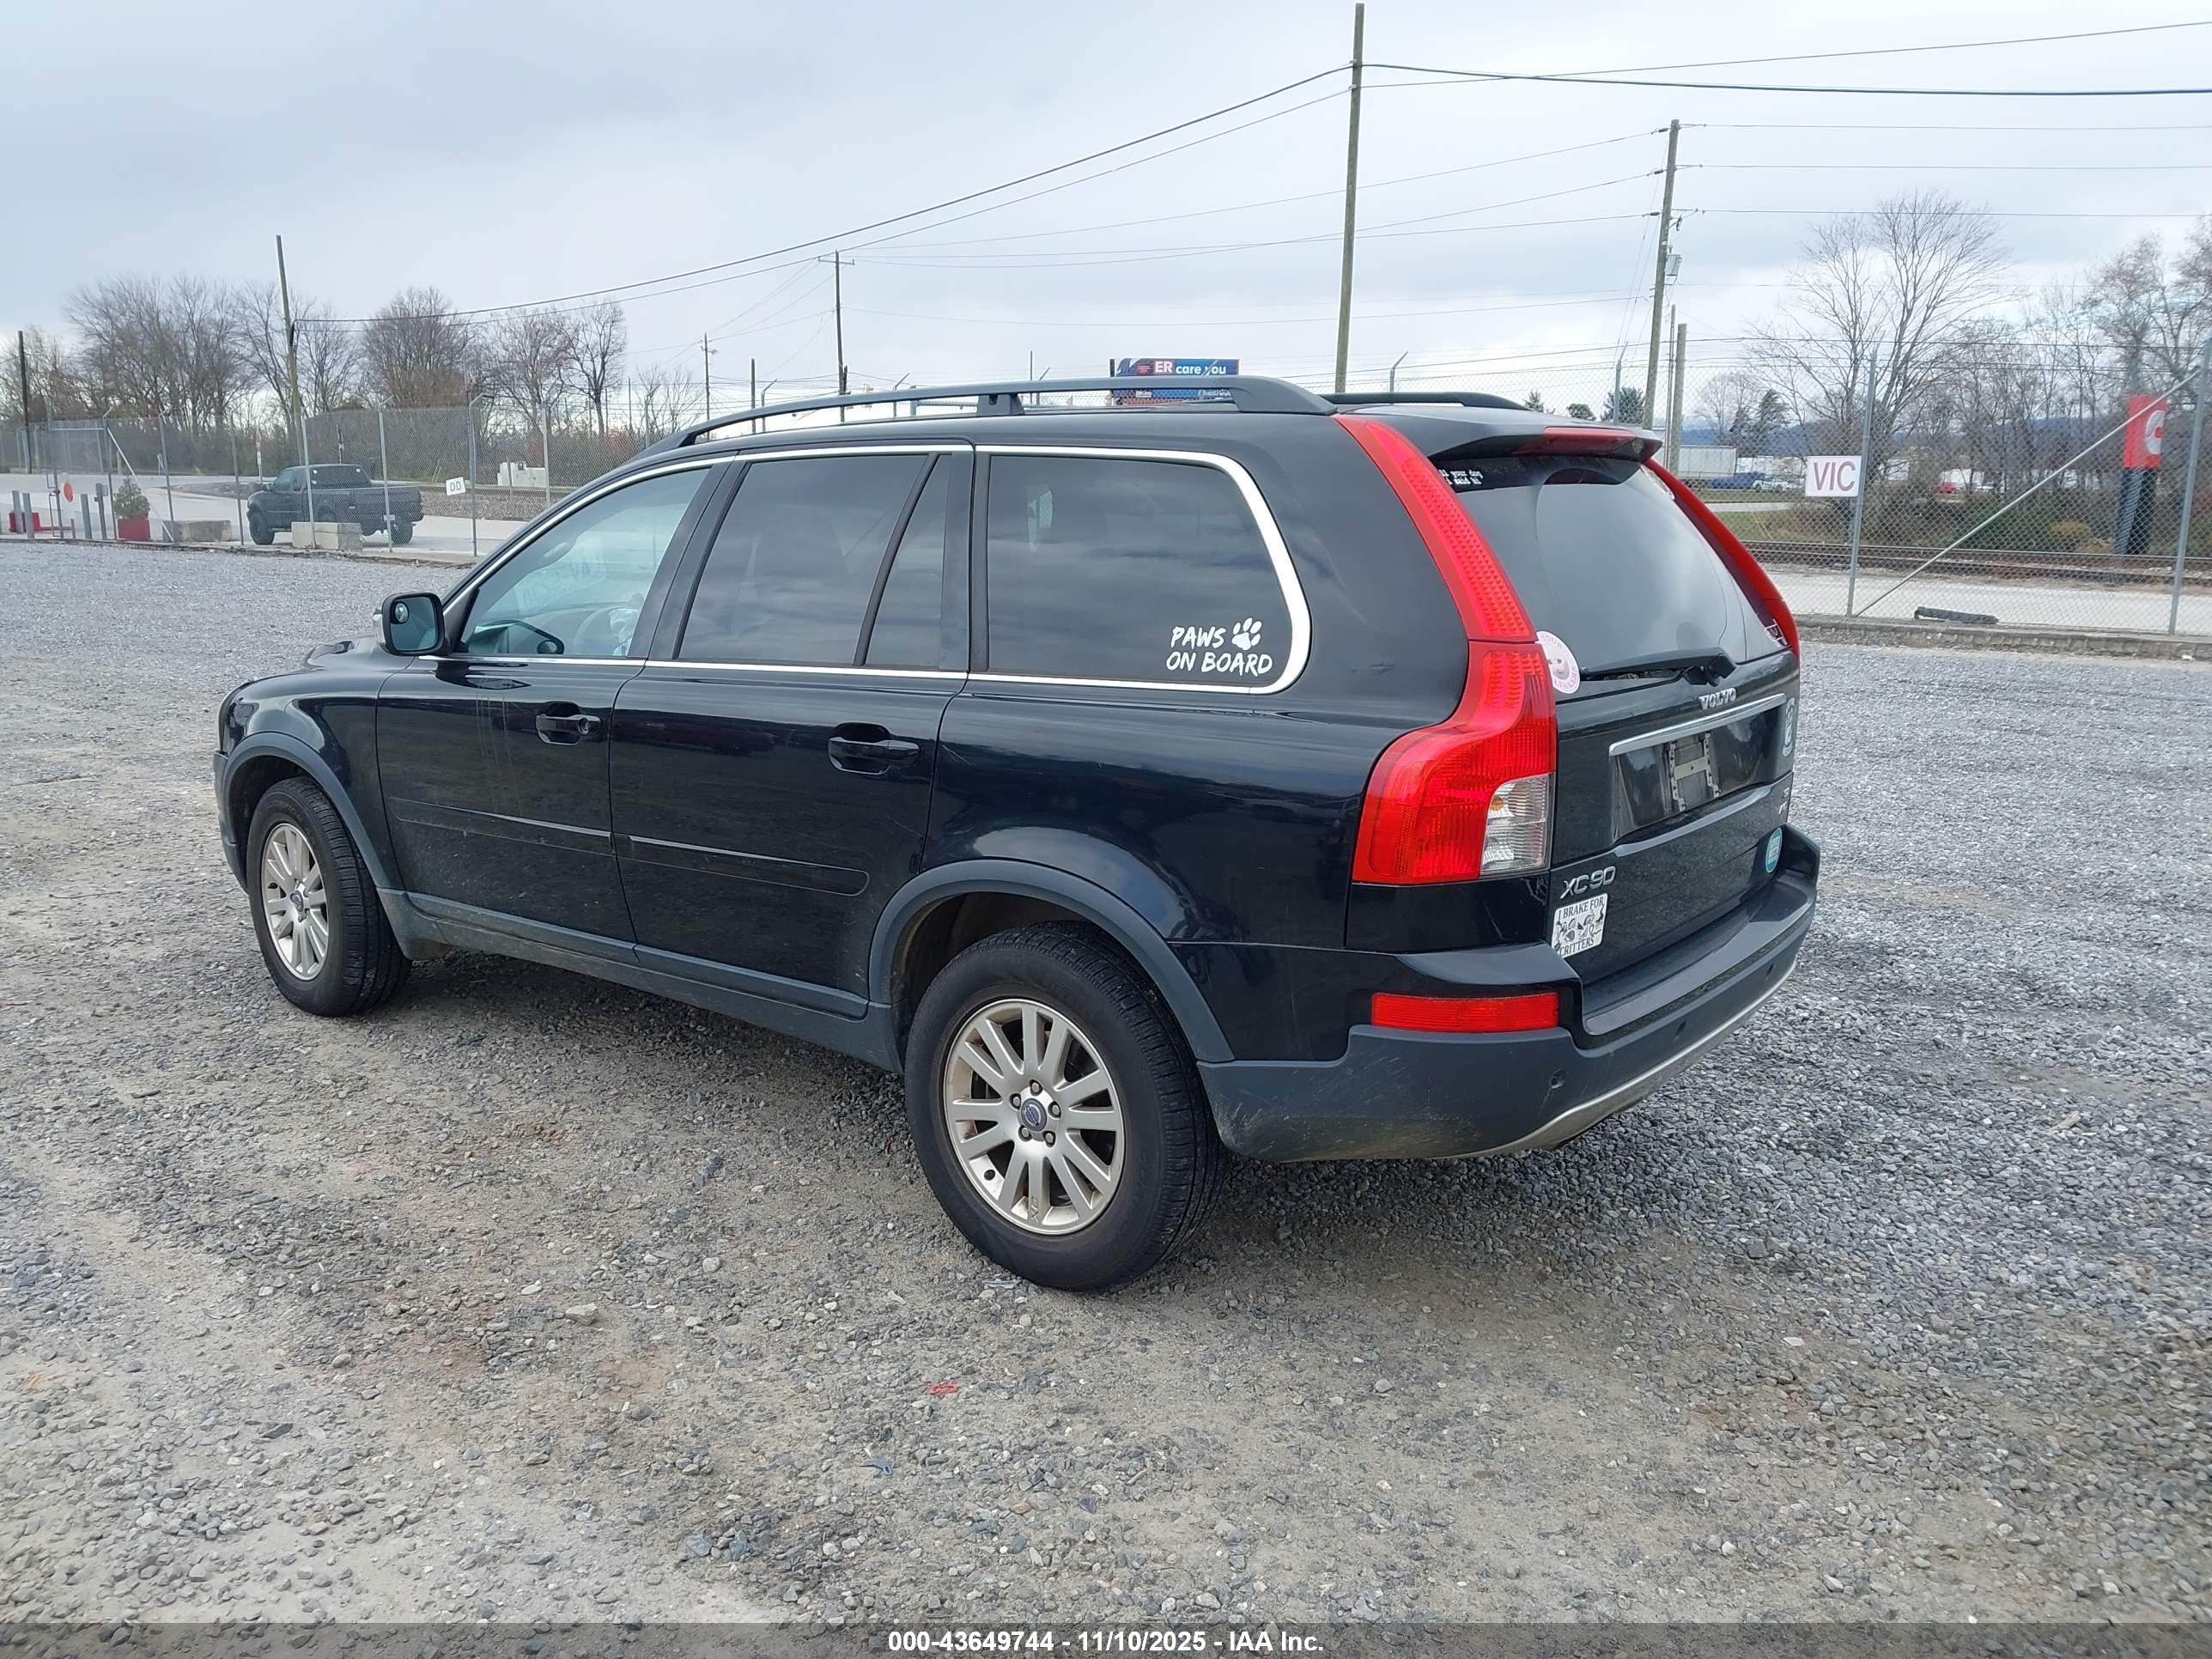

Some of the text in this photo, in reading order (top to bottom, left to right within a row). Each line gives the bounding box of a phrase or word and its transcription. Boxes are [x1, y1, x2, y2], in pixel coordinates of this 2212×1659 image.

[1155, 361, 1173, 373] ER
[1175, 365, 1201, 374] care
[449, 481, 461, 492] DD
[1814, 460, 1856, 491] VIC
[1170, 626, 1226, 649] PAWS
[1166, 651, 1273, 677] ON BOARD
[1698, 687, 1736, 710] VOLVO
[1559, 866, 1616, 899] XC90
[1563, 902, 1589, 919] BRAKE
[1589, 896, 1605, 909] FOR
[1559, 938, 1594, 957] CRITTERS
